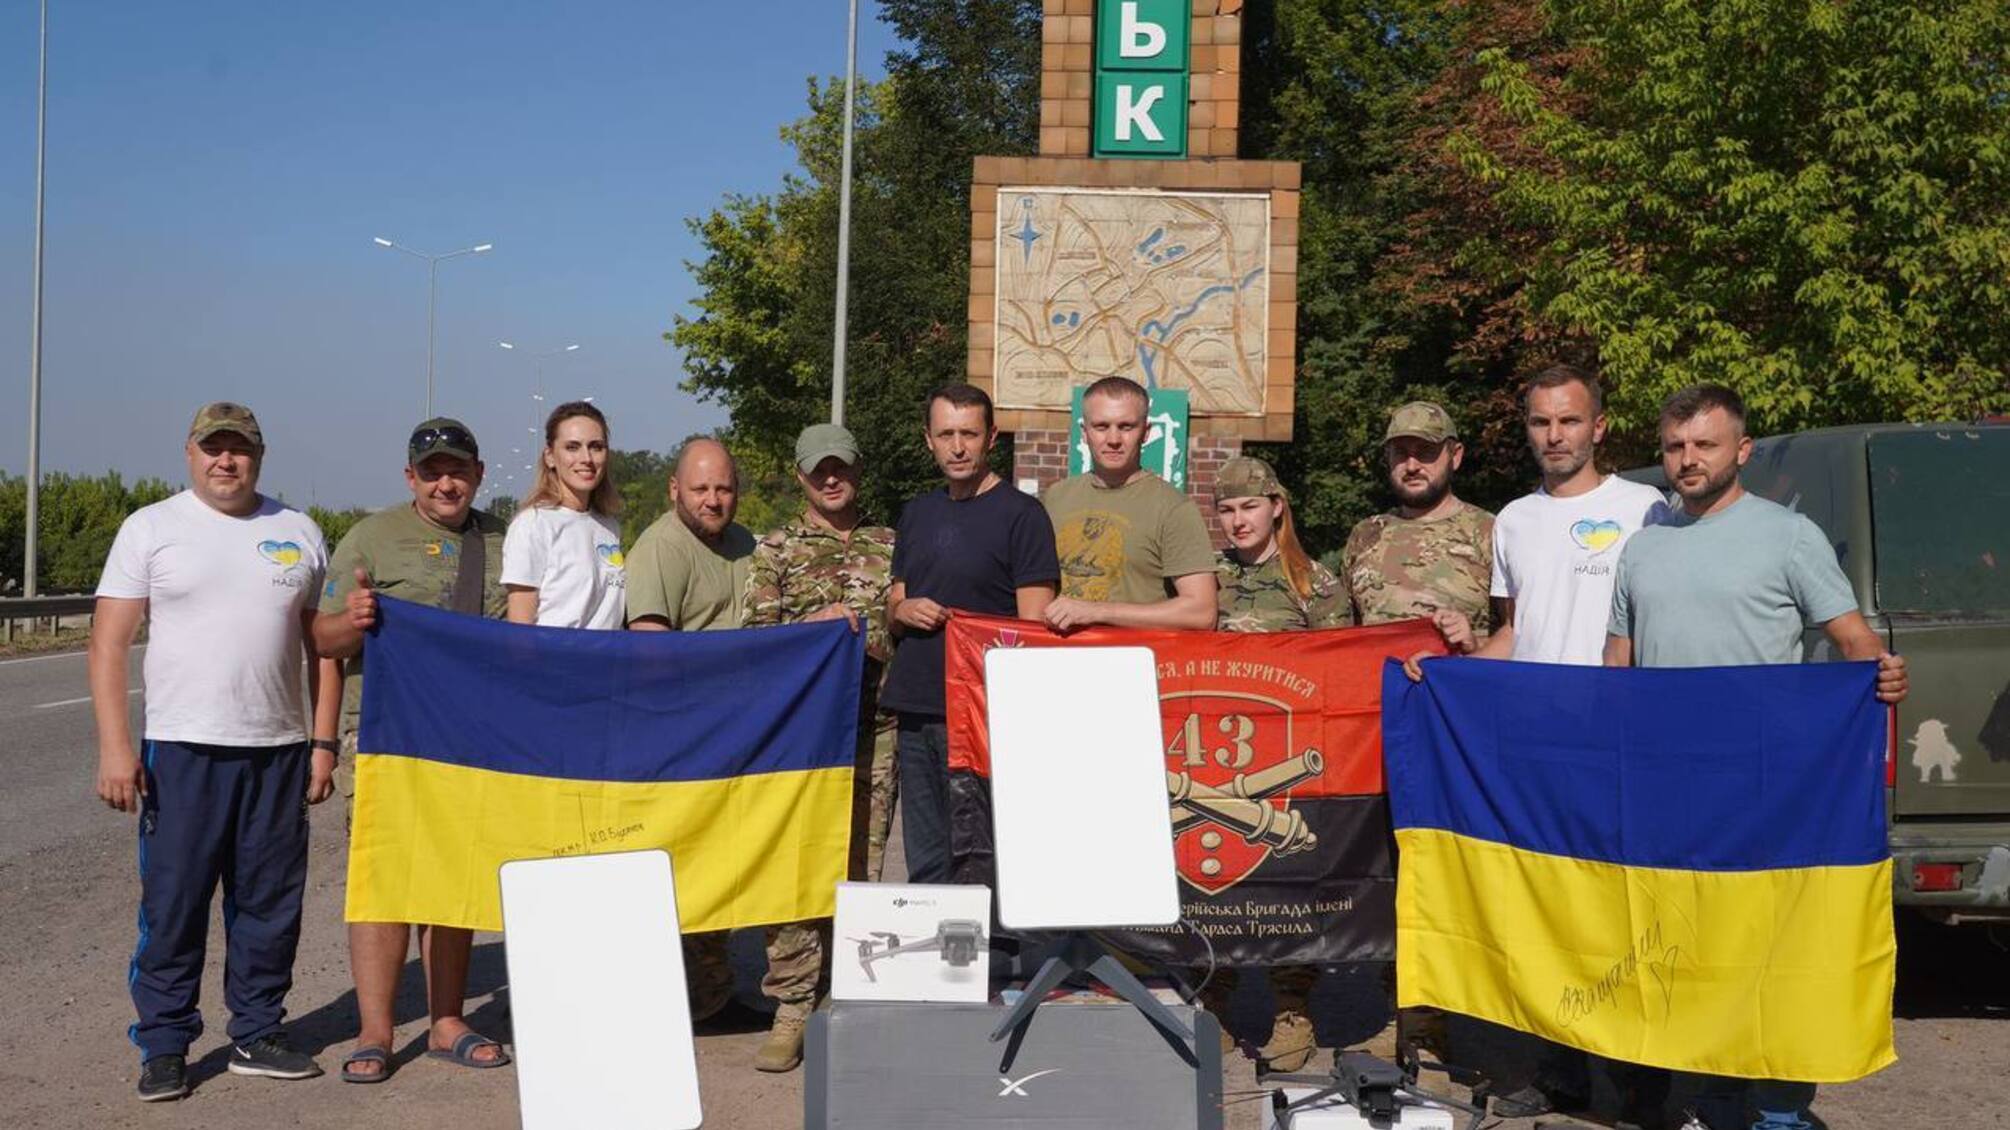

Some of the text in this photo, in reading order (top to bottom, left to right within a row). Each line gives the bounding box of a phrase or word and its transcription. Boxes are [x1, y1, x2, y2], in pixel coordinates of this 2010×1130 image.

[1201, 660, 1221, 676] НЕ
[1226, 661, 1316, 698] ЖУРИТИСЯ
[1167, 712, 1256, 769] 43
[1246, 899, 1312, 918] Бригада
[1315, 896, 1353, 913] імені
[1189, 919, 1243, 936] Тараса
[1247, 919, 1313, 938] Трясила
